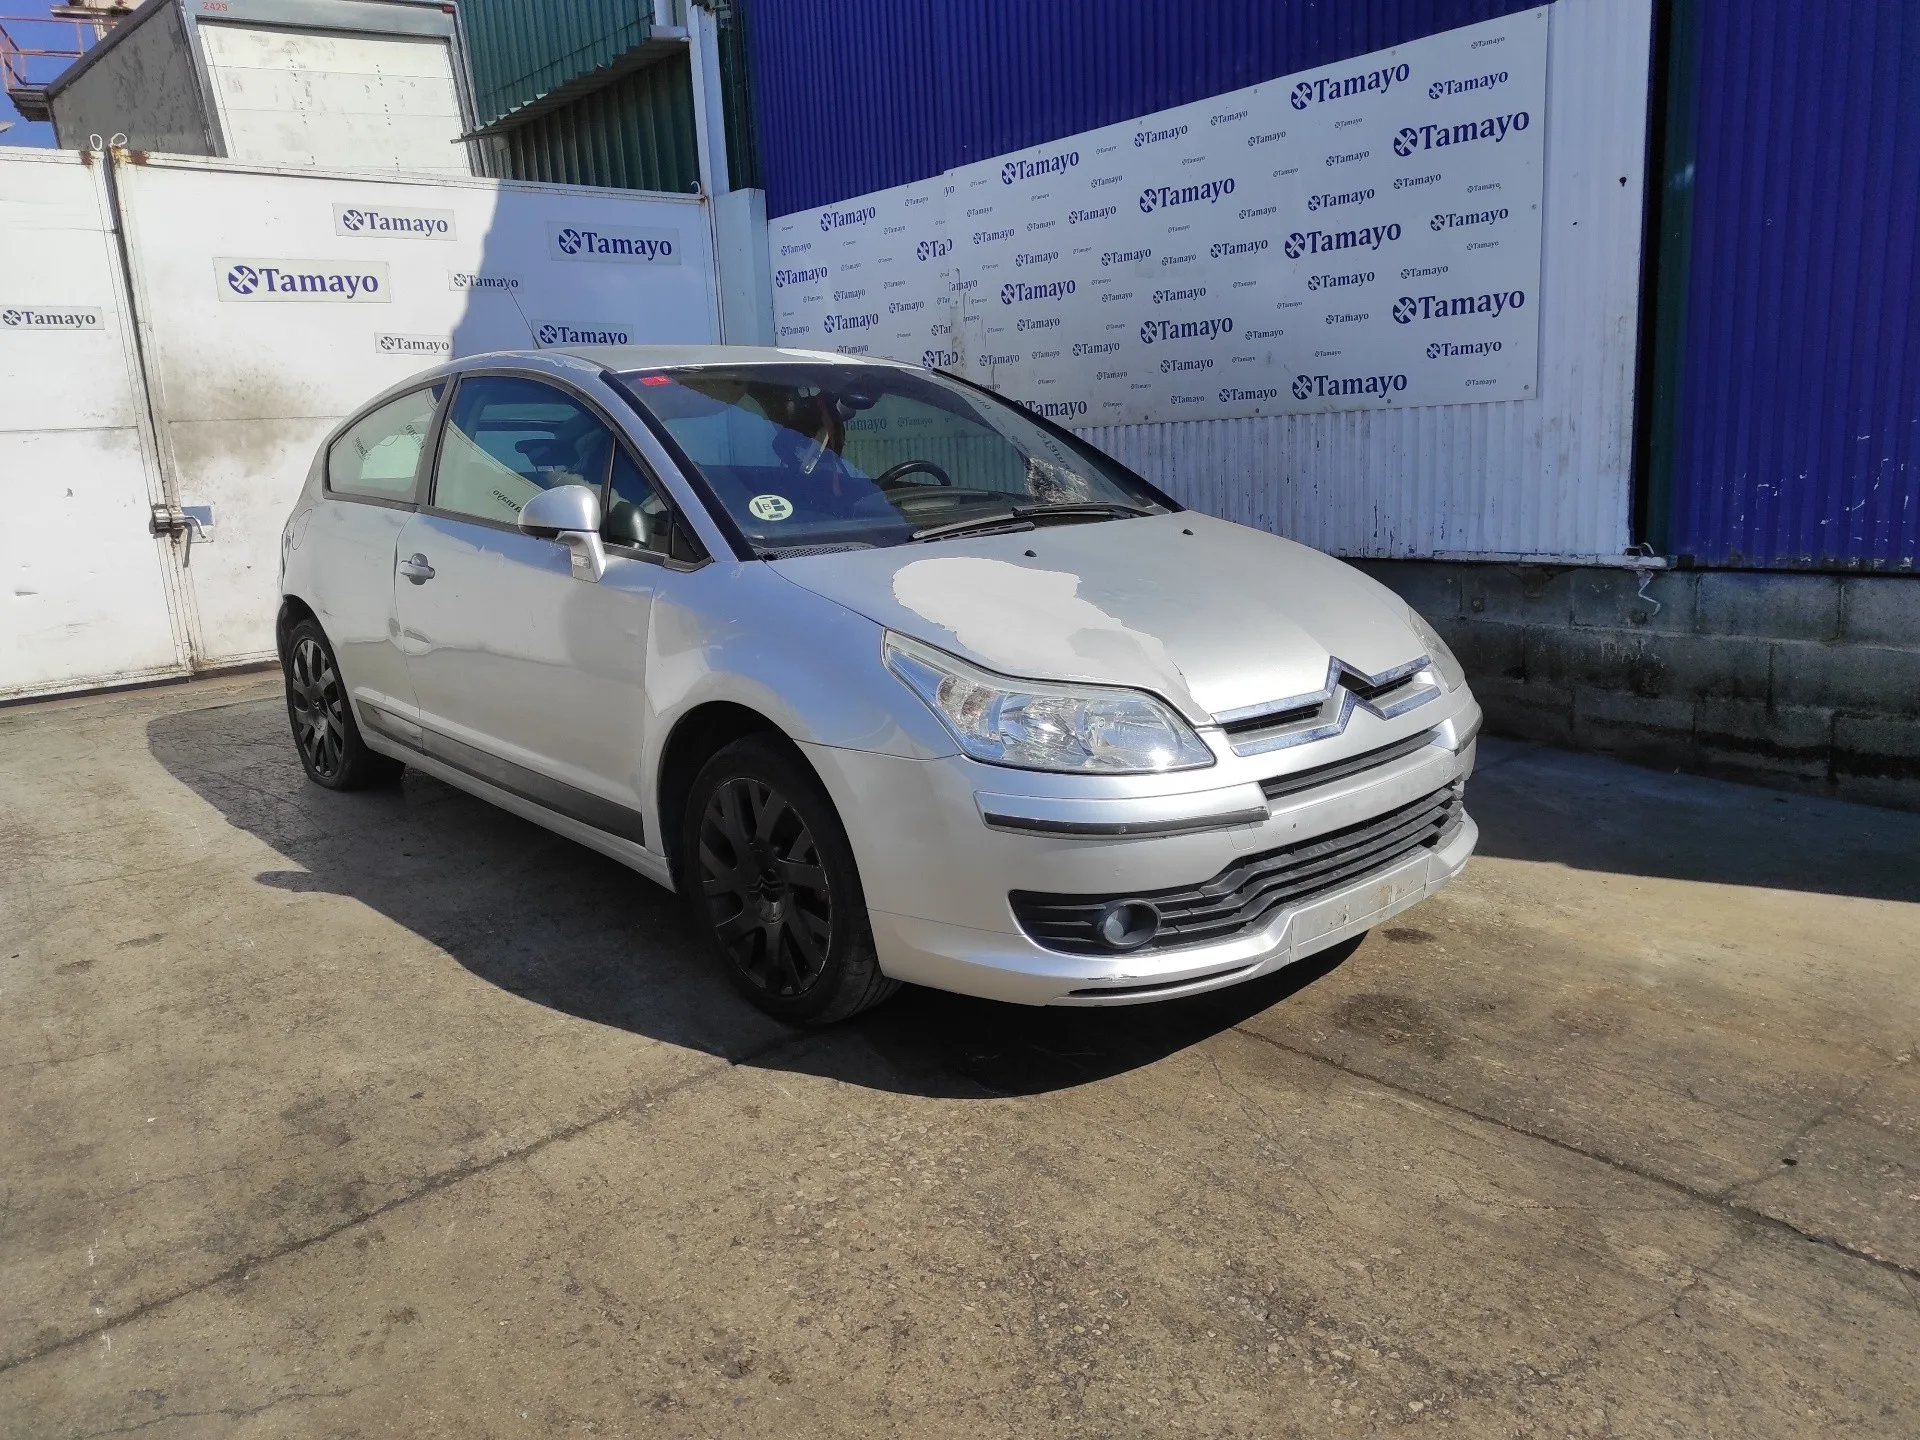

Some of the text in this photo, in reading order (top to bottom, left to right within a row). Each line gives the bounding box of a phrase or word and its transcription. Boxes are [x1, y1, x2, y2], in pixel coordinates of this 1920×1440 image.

[203, 2, 228, 11] 2429
[1477, 37, 1505, 47] Tamayo
[1314, 64, 1409, 103] Tamayo
[1444, 72, 1508, 95] Tamayo
[1218, 111, 1247, 123] Tamayo
[1144, 125, 1188, 143] Tamayo
[1255, 131, 1286, 144] Tamayo
[1420, 112, 1529, 150] Tamayo
[1334, 151, 1370, 164] Tamayo
[1017, 152, 1079, 179] Tamayo
[1097, 175, 1122, 186] Tamayo
[1403, 174, 1441, 187] Tamayo
[1473, 183, 1500, 191] Tamayo
[1158, 177, 1235, 208] Tamayo
[1321, 189, 1375, 208] Tamayo
[831, 207, 875, 228] Tamayo
[1078, 206, 1116, 222] Tamayo
[1246, 206, 1276, 217] Tamayo
[1445, 208, 1508, 227] Tamayo
[364, 212, 448, 237] Tamayo
[981, 229, 1014, 242] Tamayo
[1307, 223, 1401, 253] Tamayo
[582, 232, 672, 261] Tamayo
[787, 243, 811, 254] Tamayo
[1221, 240, 1268, 255] Tamayo
[1473, 241, 1499, 249] Tamayo
[1024, 251, 1058, 264] Tamayo
[1111, 249, 1151, 264] Tamayo
[1168, 254, 1196, 264] Tamayo
[786, 267, 827, 284] Tamayo
[1410, 266, 1448, 277] Tamayo
[259, 268, 379, 299] Tamayo
[467, 275, 519, 290] Tamayo
[1321, 272, 1375, 288] Tamayo
[840, 289, 865, 299] Tamayo
[1015, 280, 1075, 301] Tamayo
[1107, 292, 1132, 301] Tamayo
[1163, 287, 1206, 302] Tamayo
[895, 301, 924, 312] Tamayo
[1418, 291, 1525, 319] Tamayo
[22, 311, 96, 328] Tamayo
[834, 313, 878, 330] Tamayo
[1025, 318, 1060, 330] Tamayo
[1334, 313, 1369, 323] Tamayo
[558, 326, 628, 345] Tamayo
[786, 326, 810, 337] Tamayo
[1158, 318, 1233, 340] Tamayo
[1252, 330, 1283, 338] Tamayo
[394, 338, 449, 353] Tamayo
[843, 345, 868, 354] Tamayo
[1081, 343, 1119, 354] Tamayo
[1441, 341, 1502, 356] Tamayo
[988, 354, 1020, 366] Tamayo
[1170, 359, 1213, 371] Tamayo
[1102, 371, 1127, 379] Tamayo
[1314, 375, 1407, 398] Tamayo
[1177, 396, 1205, 404] Tamayo
[1230, 389, 1277, 401] Tamayo
